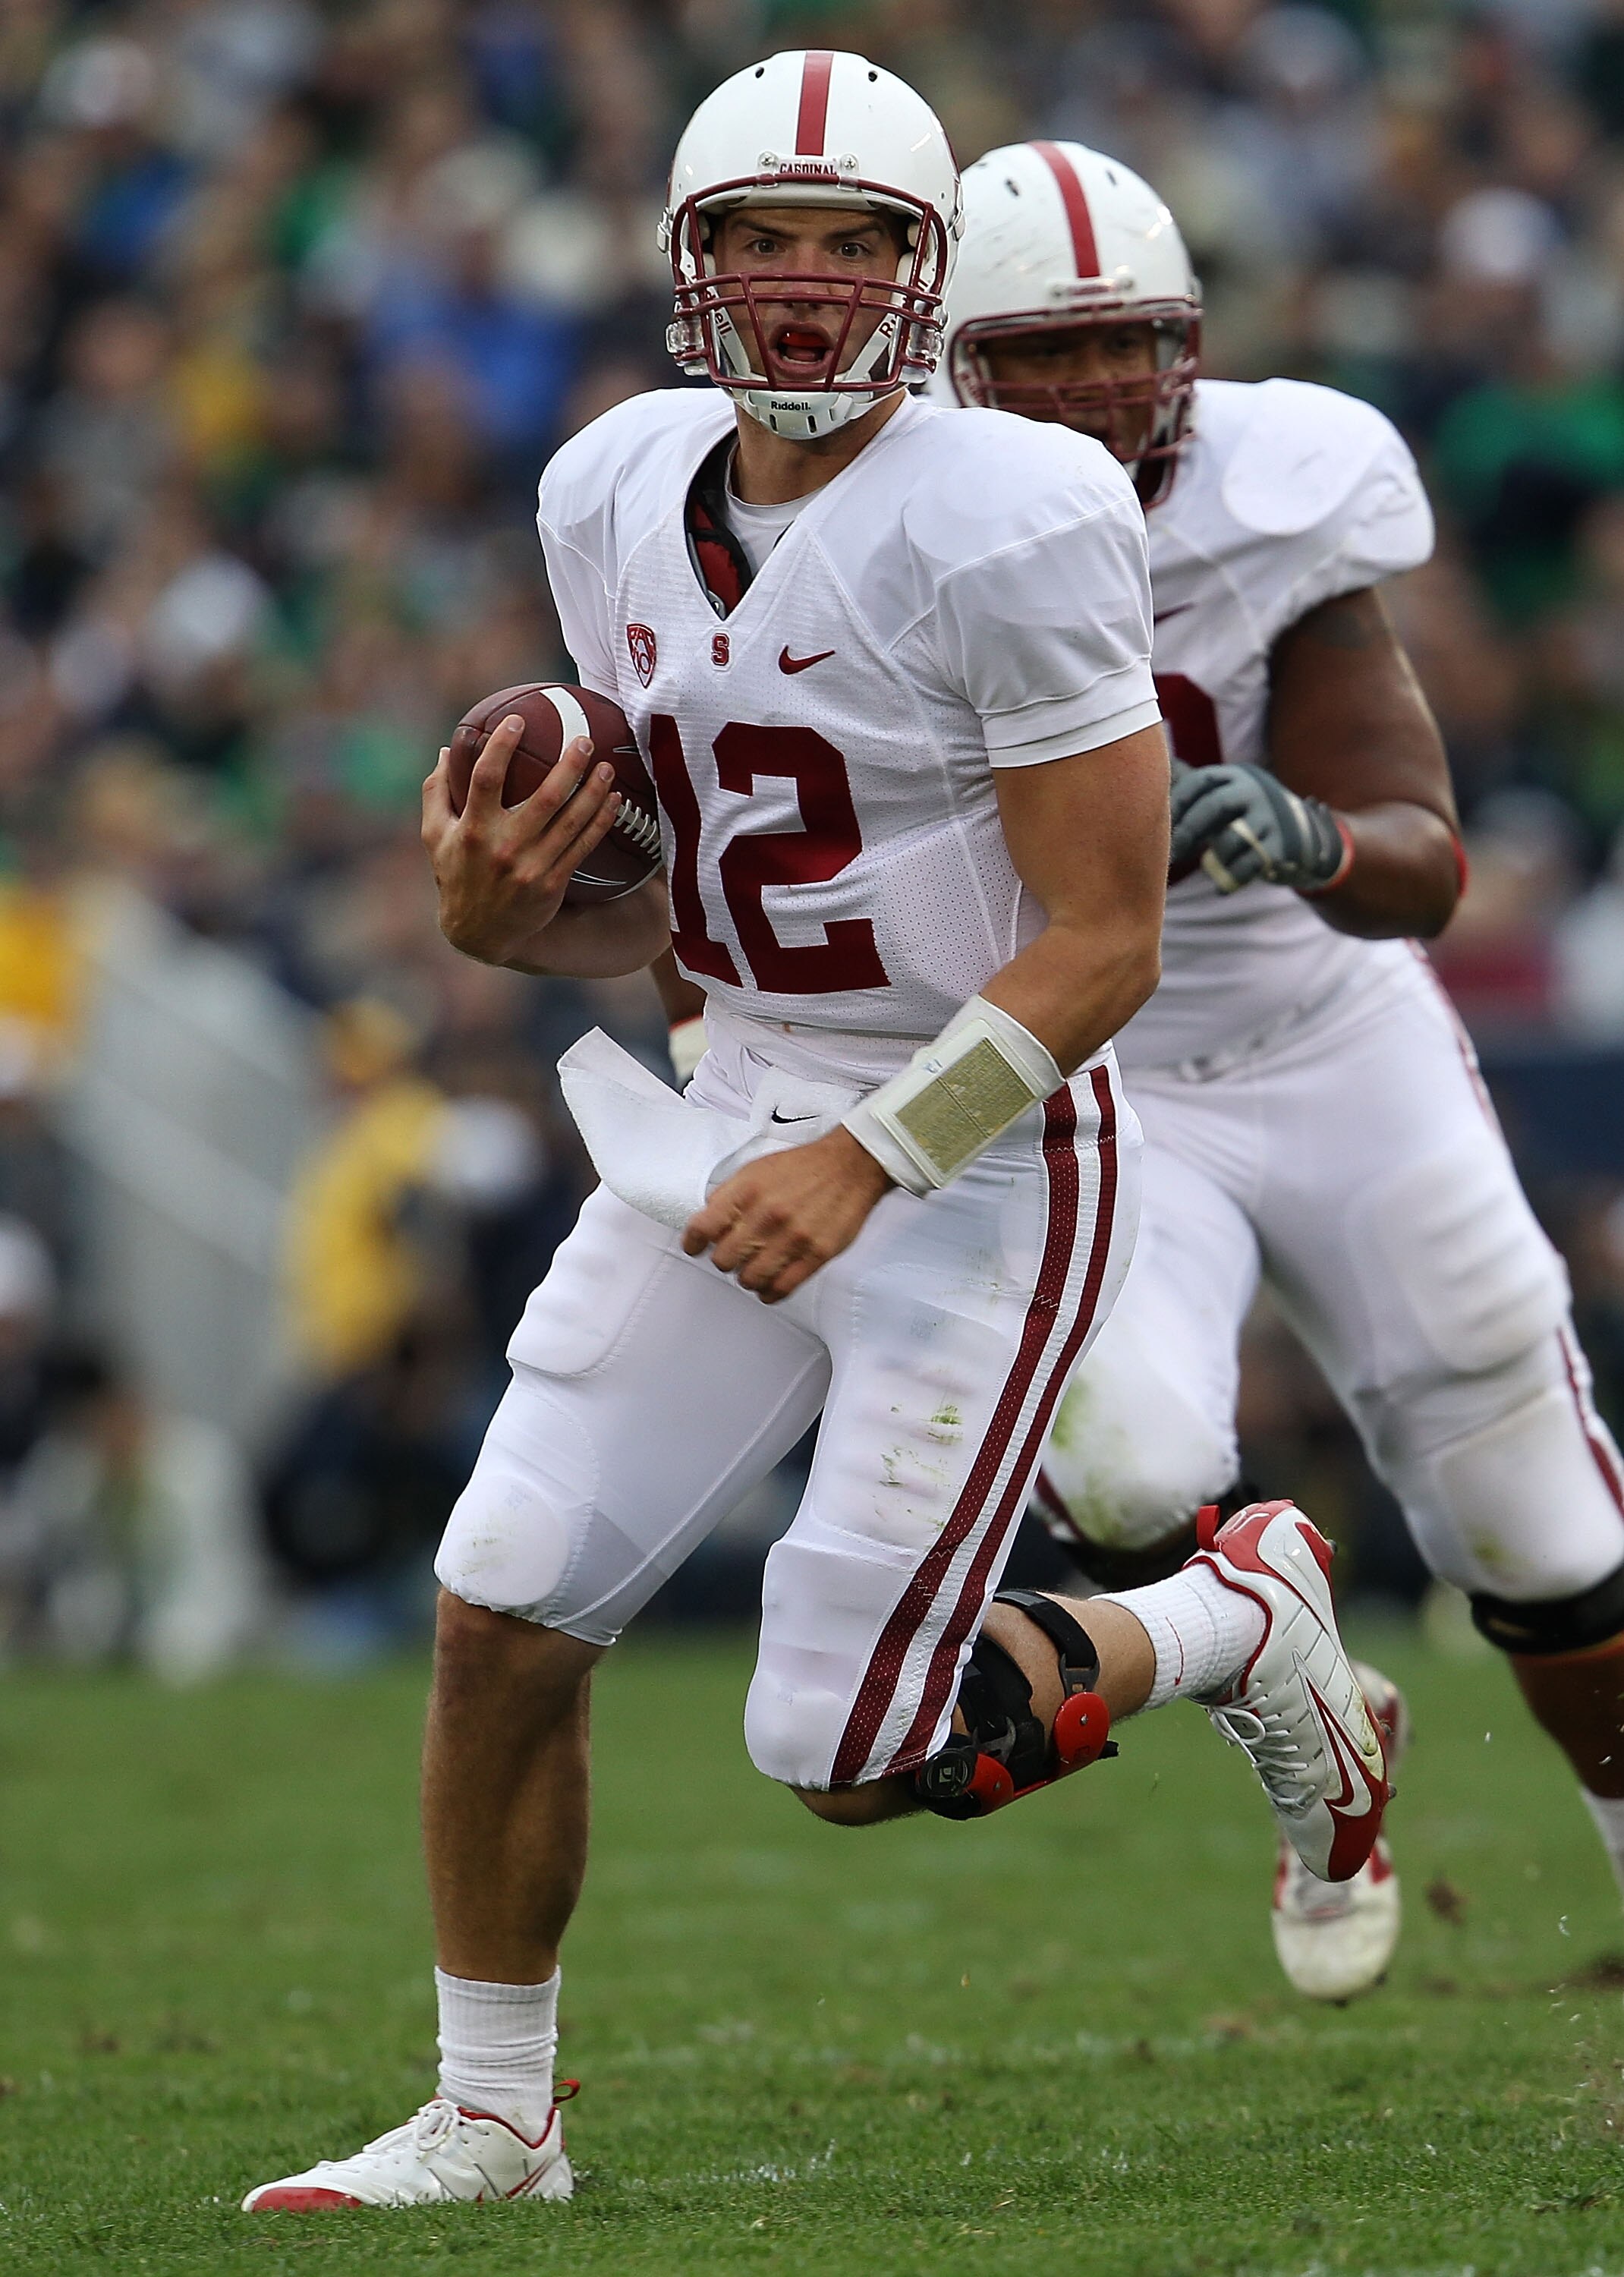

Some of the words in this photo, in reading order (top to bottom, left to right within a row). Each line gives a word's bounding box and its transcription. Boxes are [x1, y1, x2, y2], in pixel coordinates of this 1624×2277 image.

[779, 162, 837, 175] CARDINAL
[711, 633, 729, 666] S
[648, 713, 892, 995] 12
